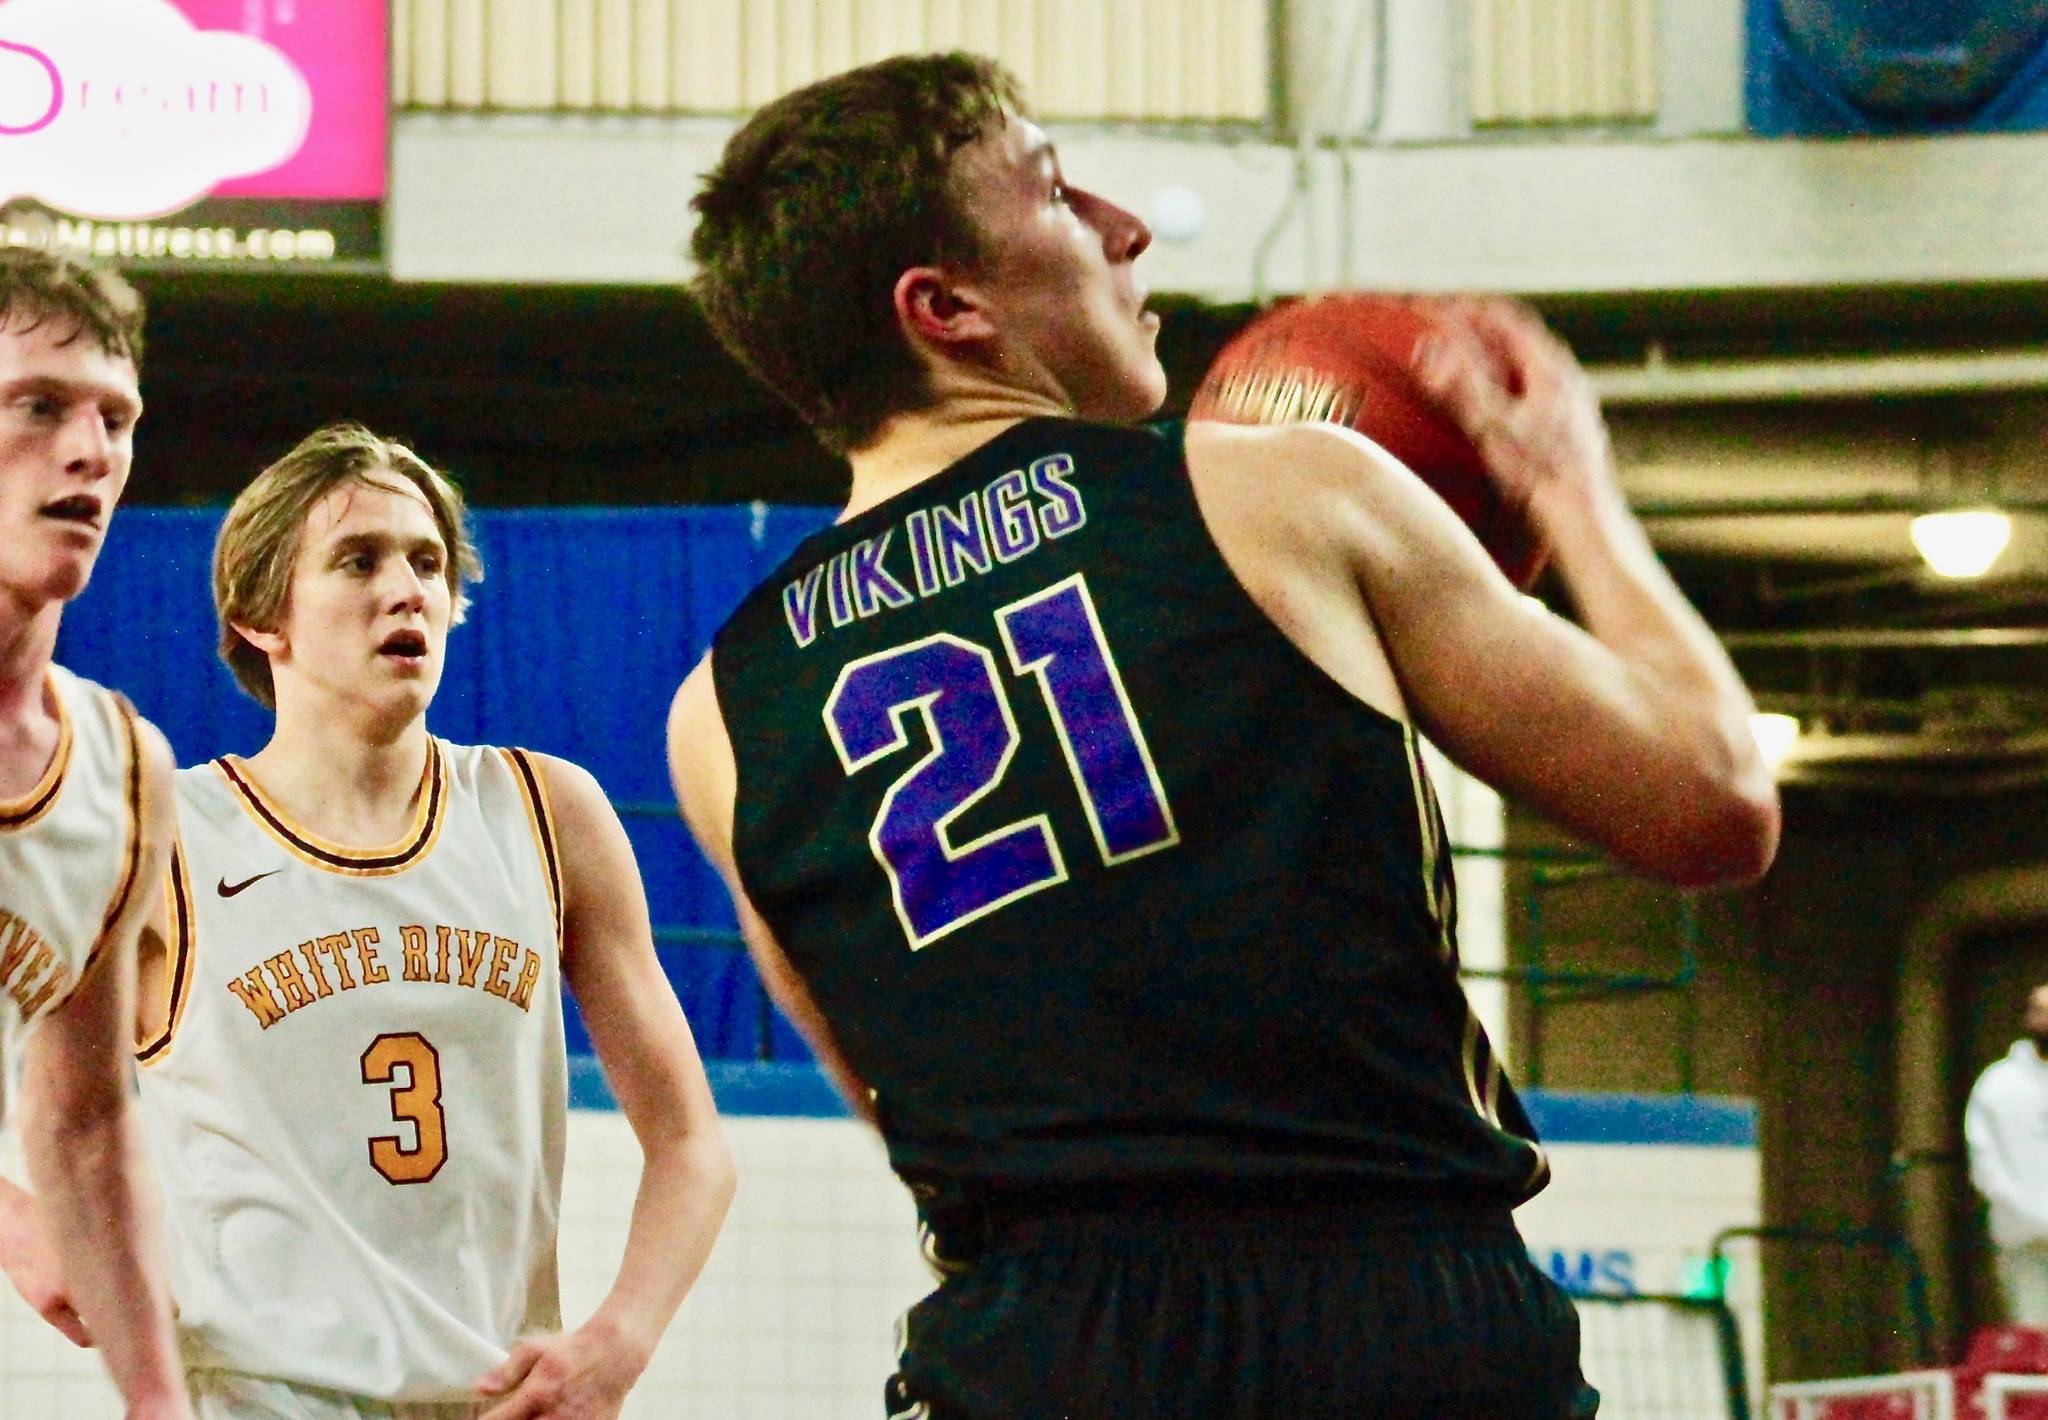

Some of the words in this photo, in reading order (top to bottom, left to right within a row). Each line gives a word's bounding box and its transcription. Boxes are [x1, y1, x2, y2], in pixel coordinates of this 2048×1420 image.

[783, 453, 1087, 648] VIKINGS
[822, 572, 1180, 952] 21
[227, 926, 390, 1031] WHITE
[399, 924, 542, 1013] RIVER
[360, 1031, 448, 1186] 3
